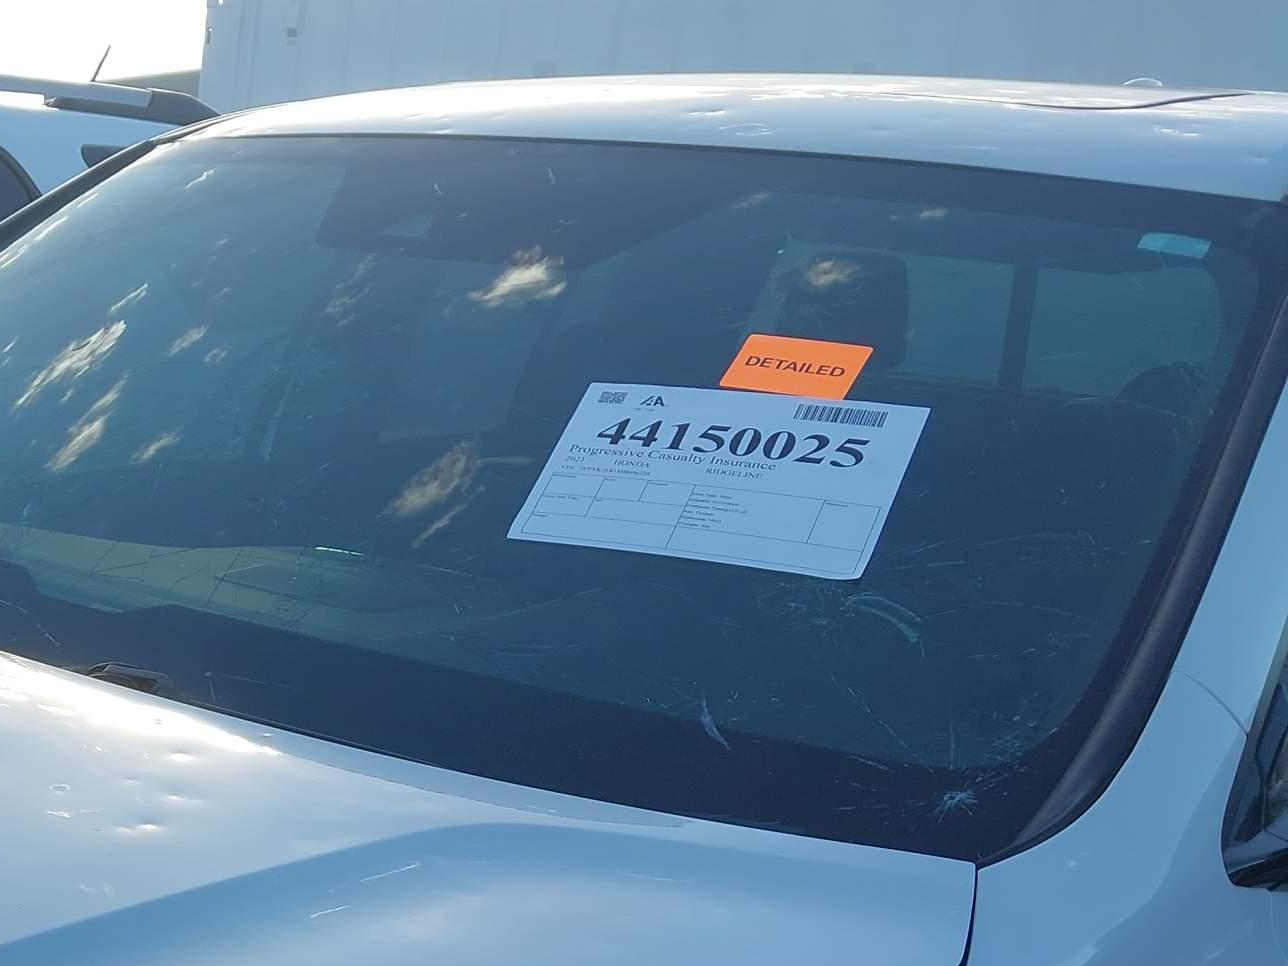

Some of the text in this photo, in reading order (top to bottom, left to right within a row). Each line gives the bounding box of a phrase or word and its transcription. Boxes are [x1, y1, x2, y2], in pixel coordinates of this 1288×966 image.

[745, 355, 846, 377] DETAILED
[597, 416, 871, 469] 44150025
[569, 444, 777, 471] Progressive Casualty Insurance
[614, 459, 650, 468] HONDA
